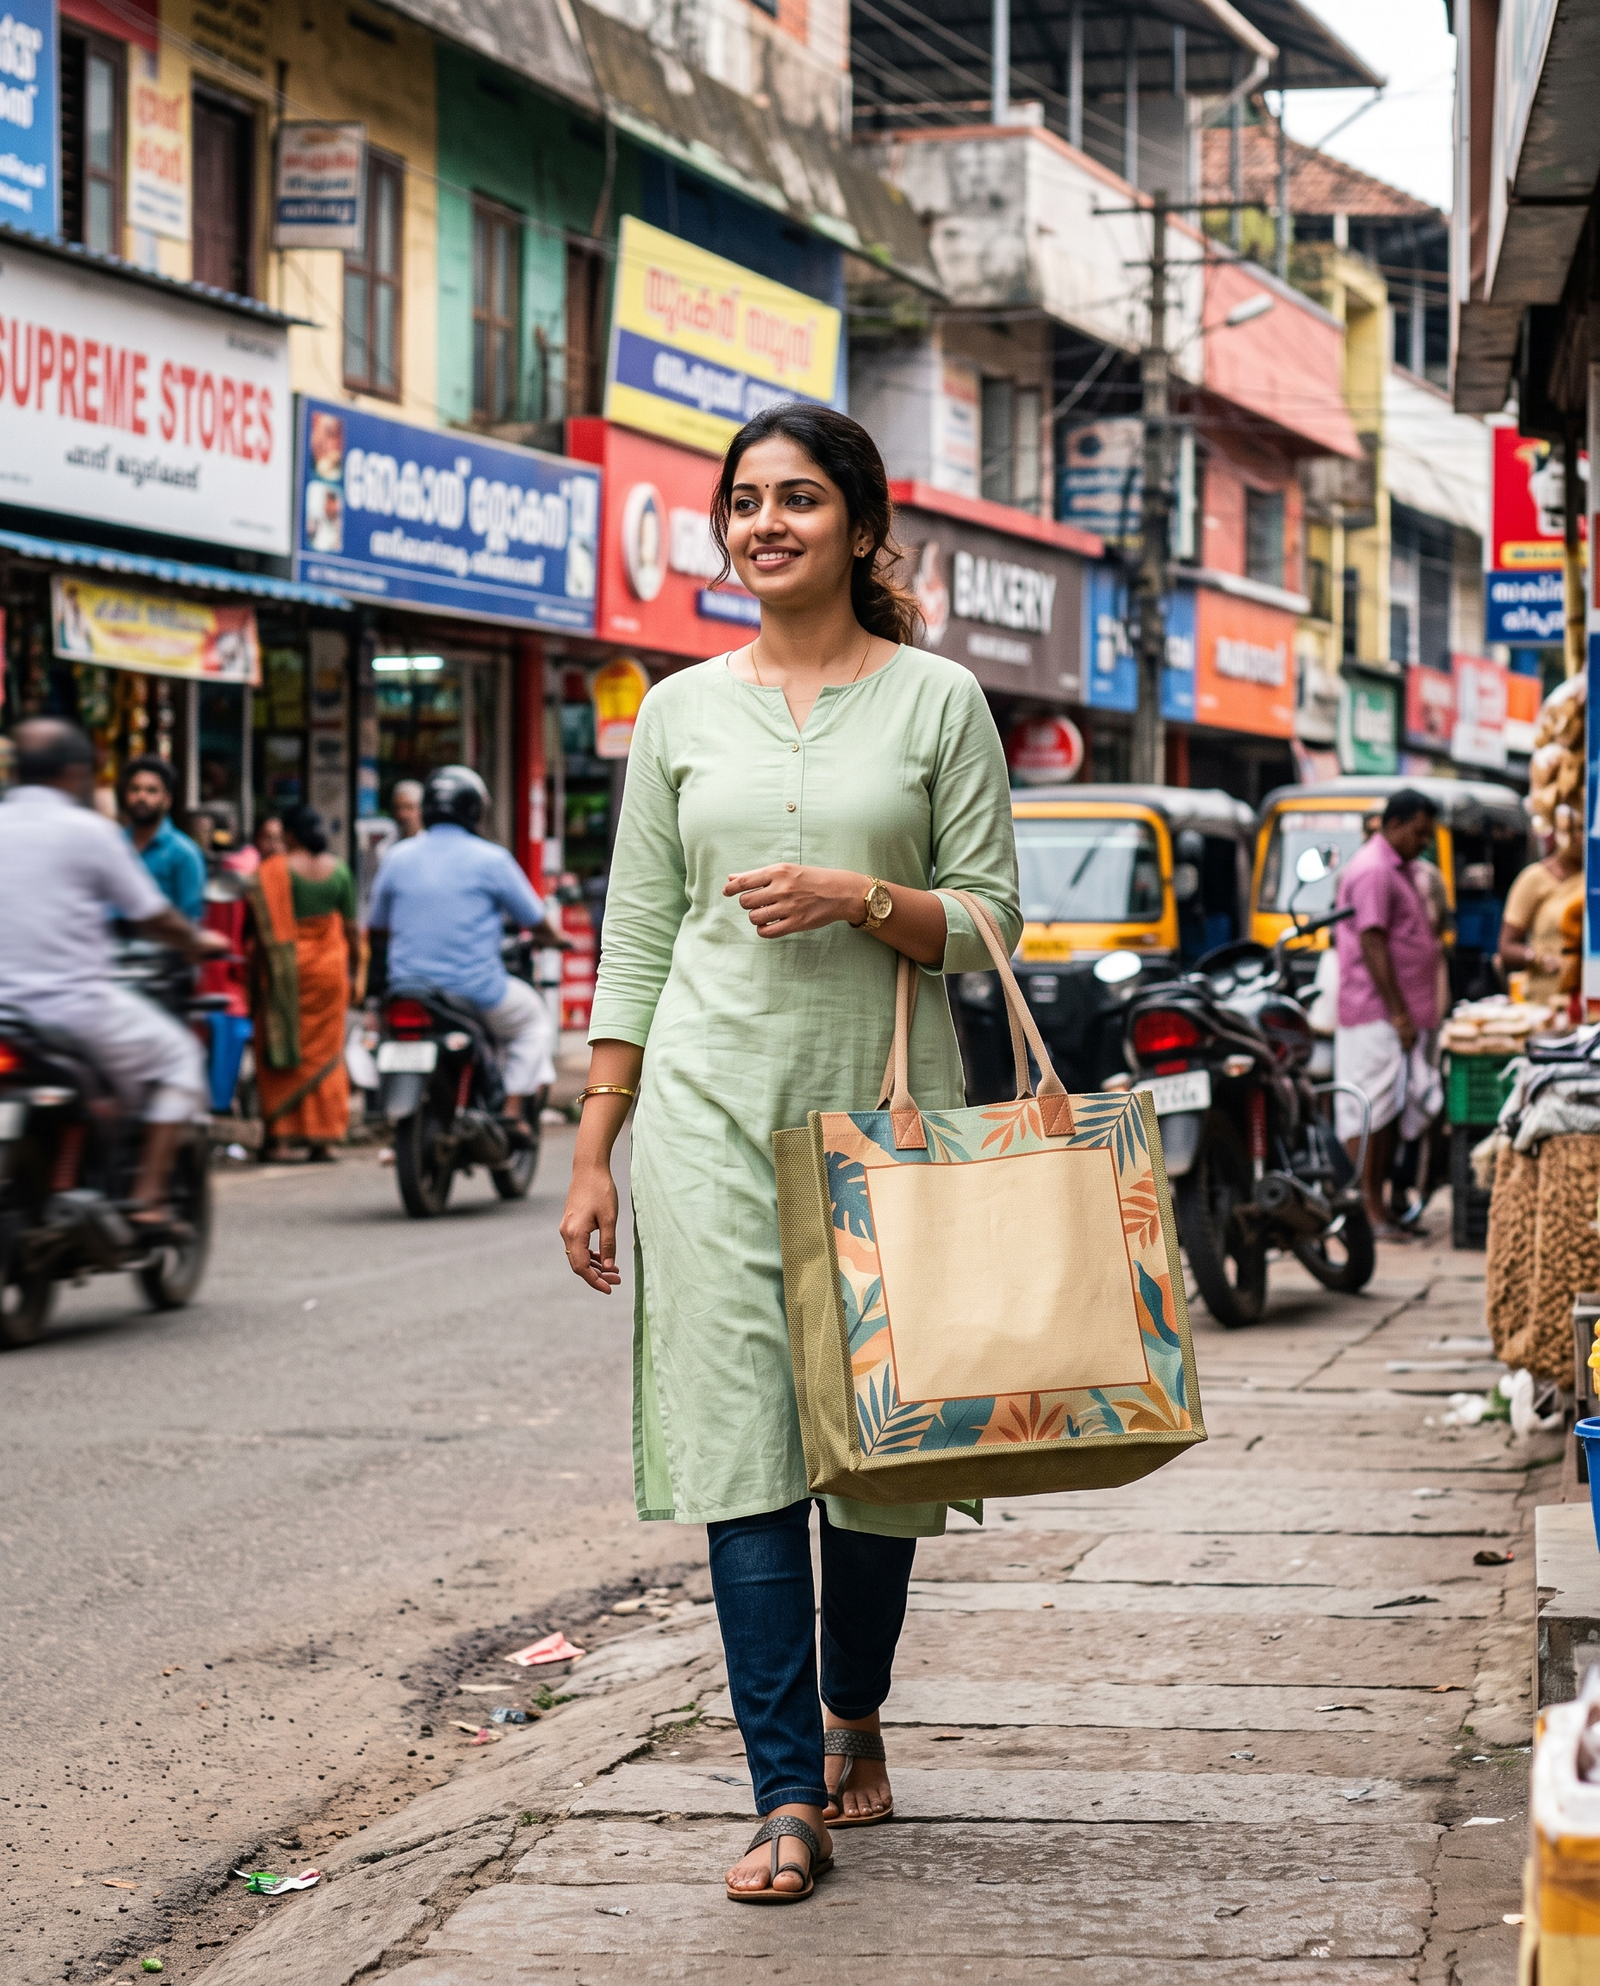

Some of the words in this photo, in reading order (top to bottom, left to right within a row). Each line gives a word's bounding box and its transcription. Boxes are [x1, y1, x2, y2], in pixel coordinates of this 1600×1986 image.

[0, 313, 147, 436] UPREME
[159, 360, 273, 465] STORES
[953, 550, 1057, 636] BAKERY
